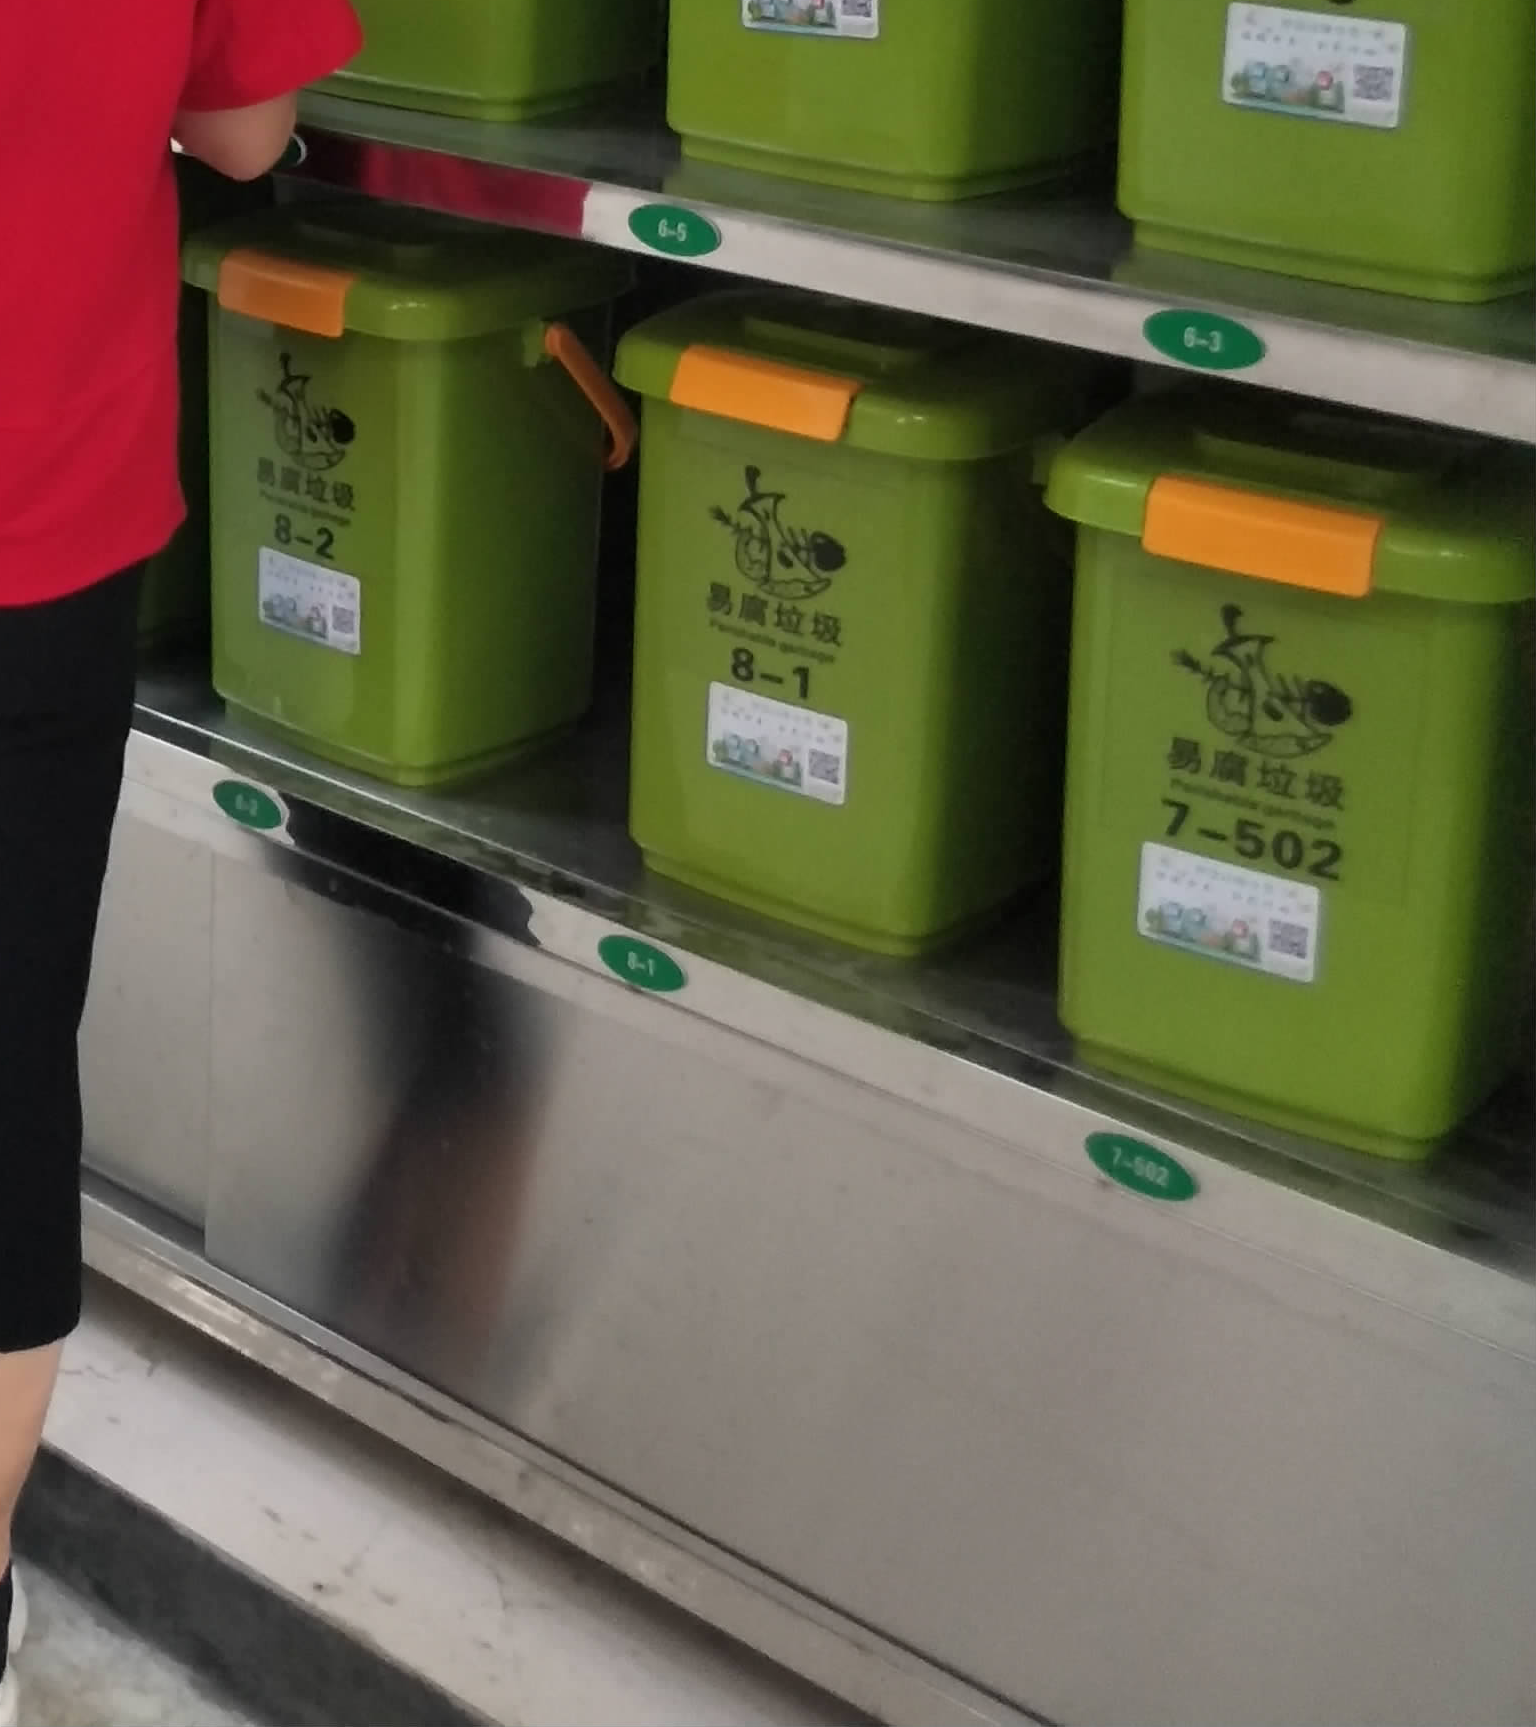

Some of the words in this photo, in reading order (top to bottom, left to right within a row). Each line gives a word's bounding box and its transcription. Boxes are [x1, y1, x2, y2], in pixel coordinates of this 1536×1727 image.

[658, 219, 688, 242] 6-5
[1183, 327, 1223, 353] 6-3
[257, 457, 356, 511] 易腐垃圾
[275, 513, 335, 561] 8-2
[708, 582, 842, 647] 易腐垃圾
[732, 647, 810, 699] 8-1
[1168, 736, 1344, 811] 易腐垃圾
[1162, 798, 1342, 881] 7-502
[1113, 1146, 1168, 1187] 7-502
